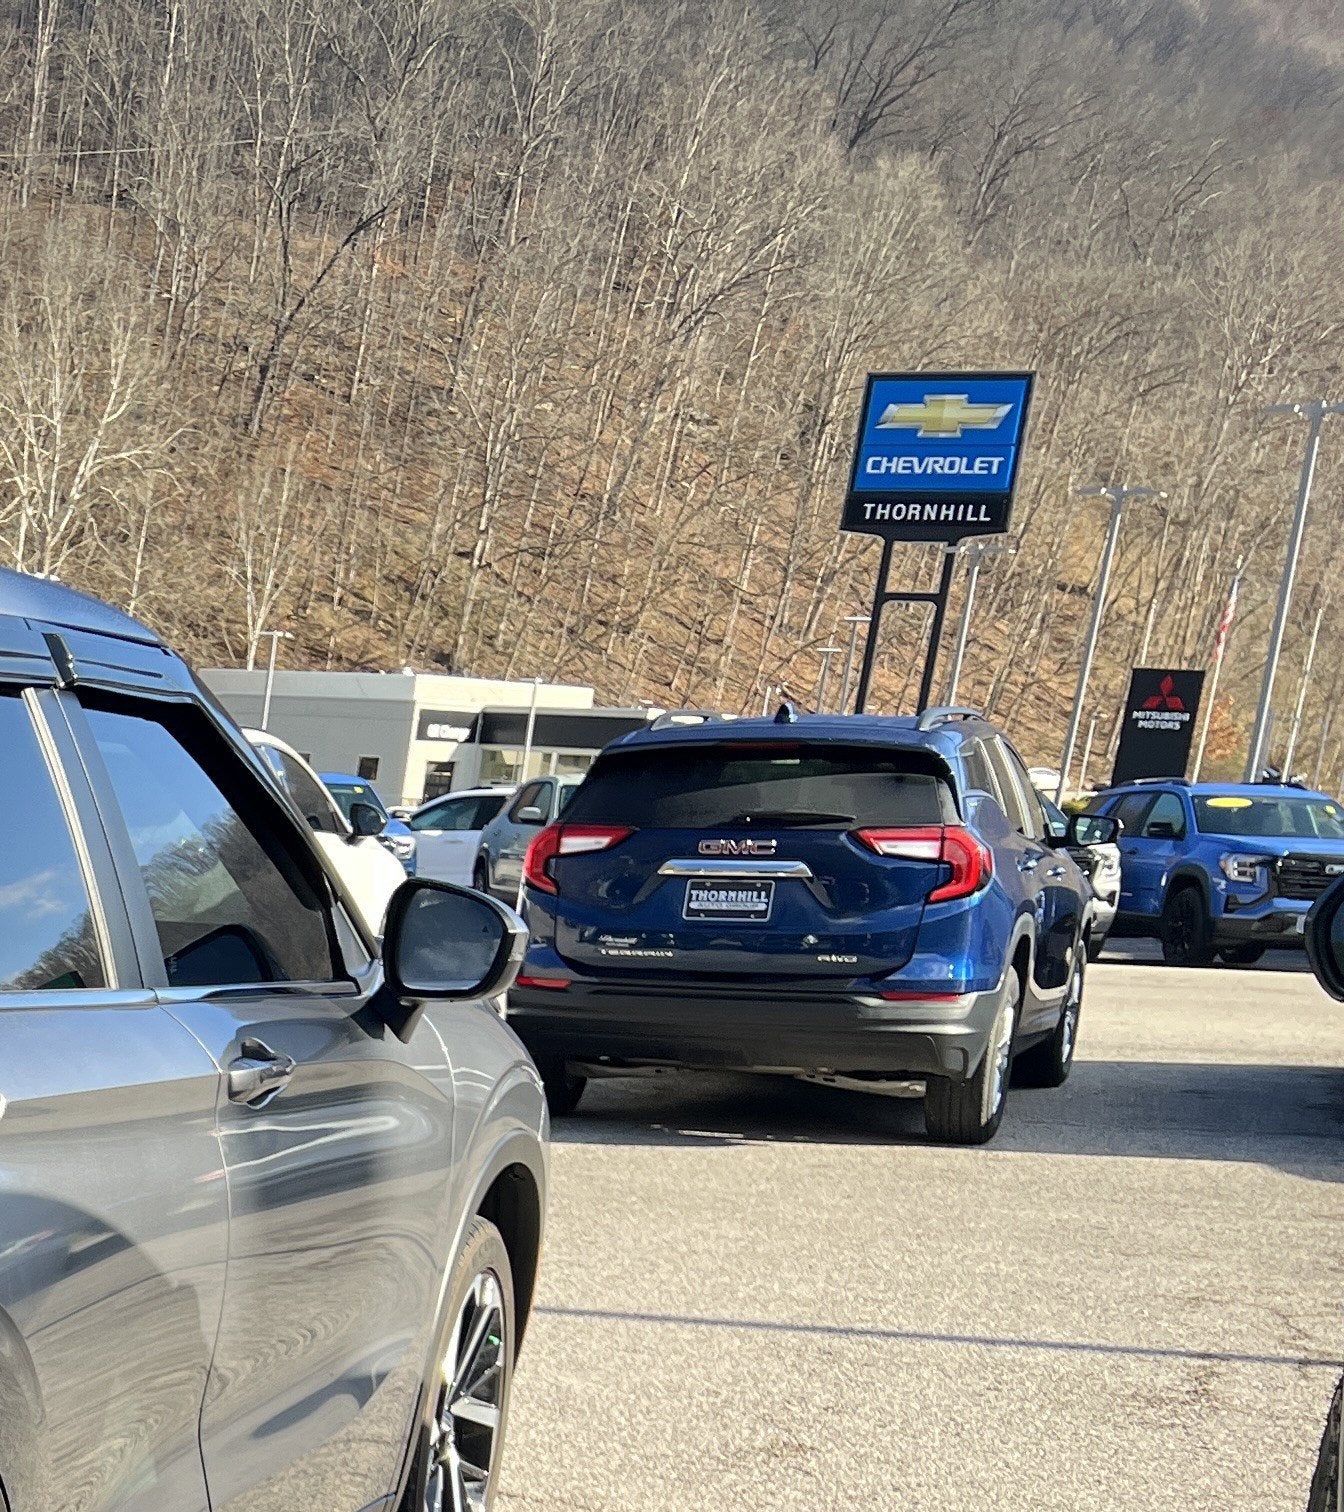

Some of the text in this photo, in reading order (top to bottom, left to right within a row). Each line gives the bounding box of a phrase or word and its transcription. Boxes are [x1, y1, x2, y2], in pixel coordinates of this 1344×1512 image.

[865, 456, 1005, 475] CHEVROLET
[863, 502, 992, 522] THORNHILL
[1132, 710, 1191, 722] MITSUBISHI
[1137, 720, 1181, 731] MOTORS
[698, 839, 777, 855] GMC
[690, 889, 769, 903] THORNHILL
